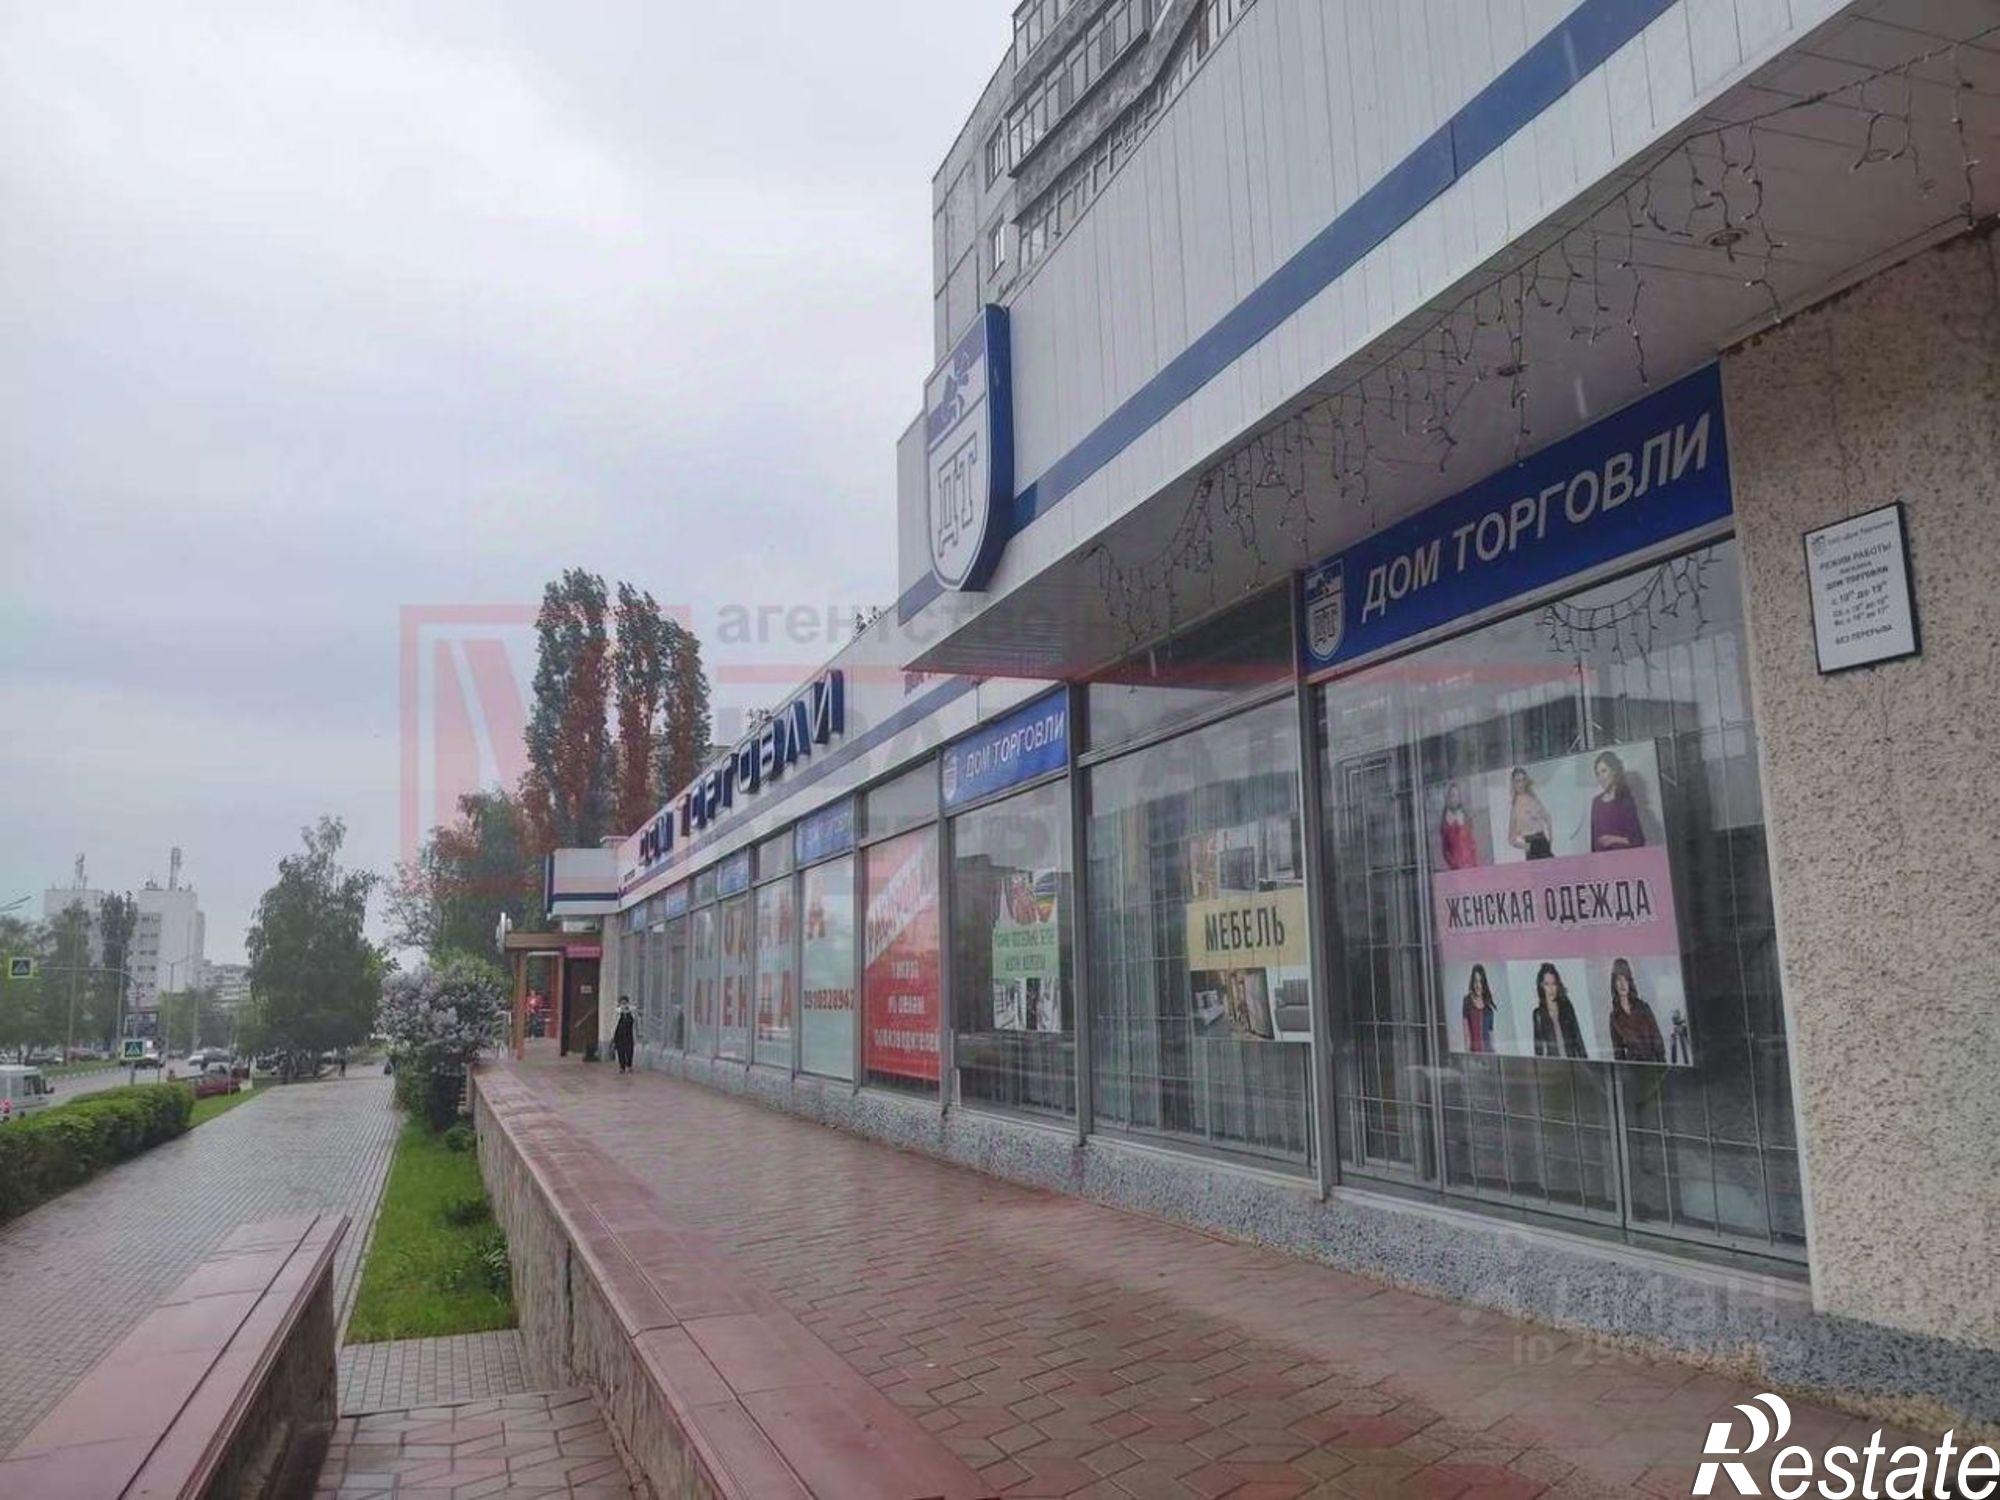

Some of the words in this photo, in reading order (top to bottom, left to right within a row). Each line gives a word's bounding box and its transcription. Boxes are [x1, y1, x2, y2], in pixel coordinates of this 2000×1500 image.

[1362, 539, 1443, 624] ДОМ
[1453, 412, 1711, 573] ТОРГОВЛИ
[676, 668, 845, 837] ТОРГОВЛИ
[964, 744, 991, 779] ДОМ
[993, 711, 1066, 763] ТОРГОВЛИ
[1204, 905, 1286, 952] МЕБЕЛЬ
[1445, 889, 1535, 929] ЖЕНСКАЯ
[1545, 878, 1652, 925] ОДЕЖДА
